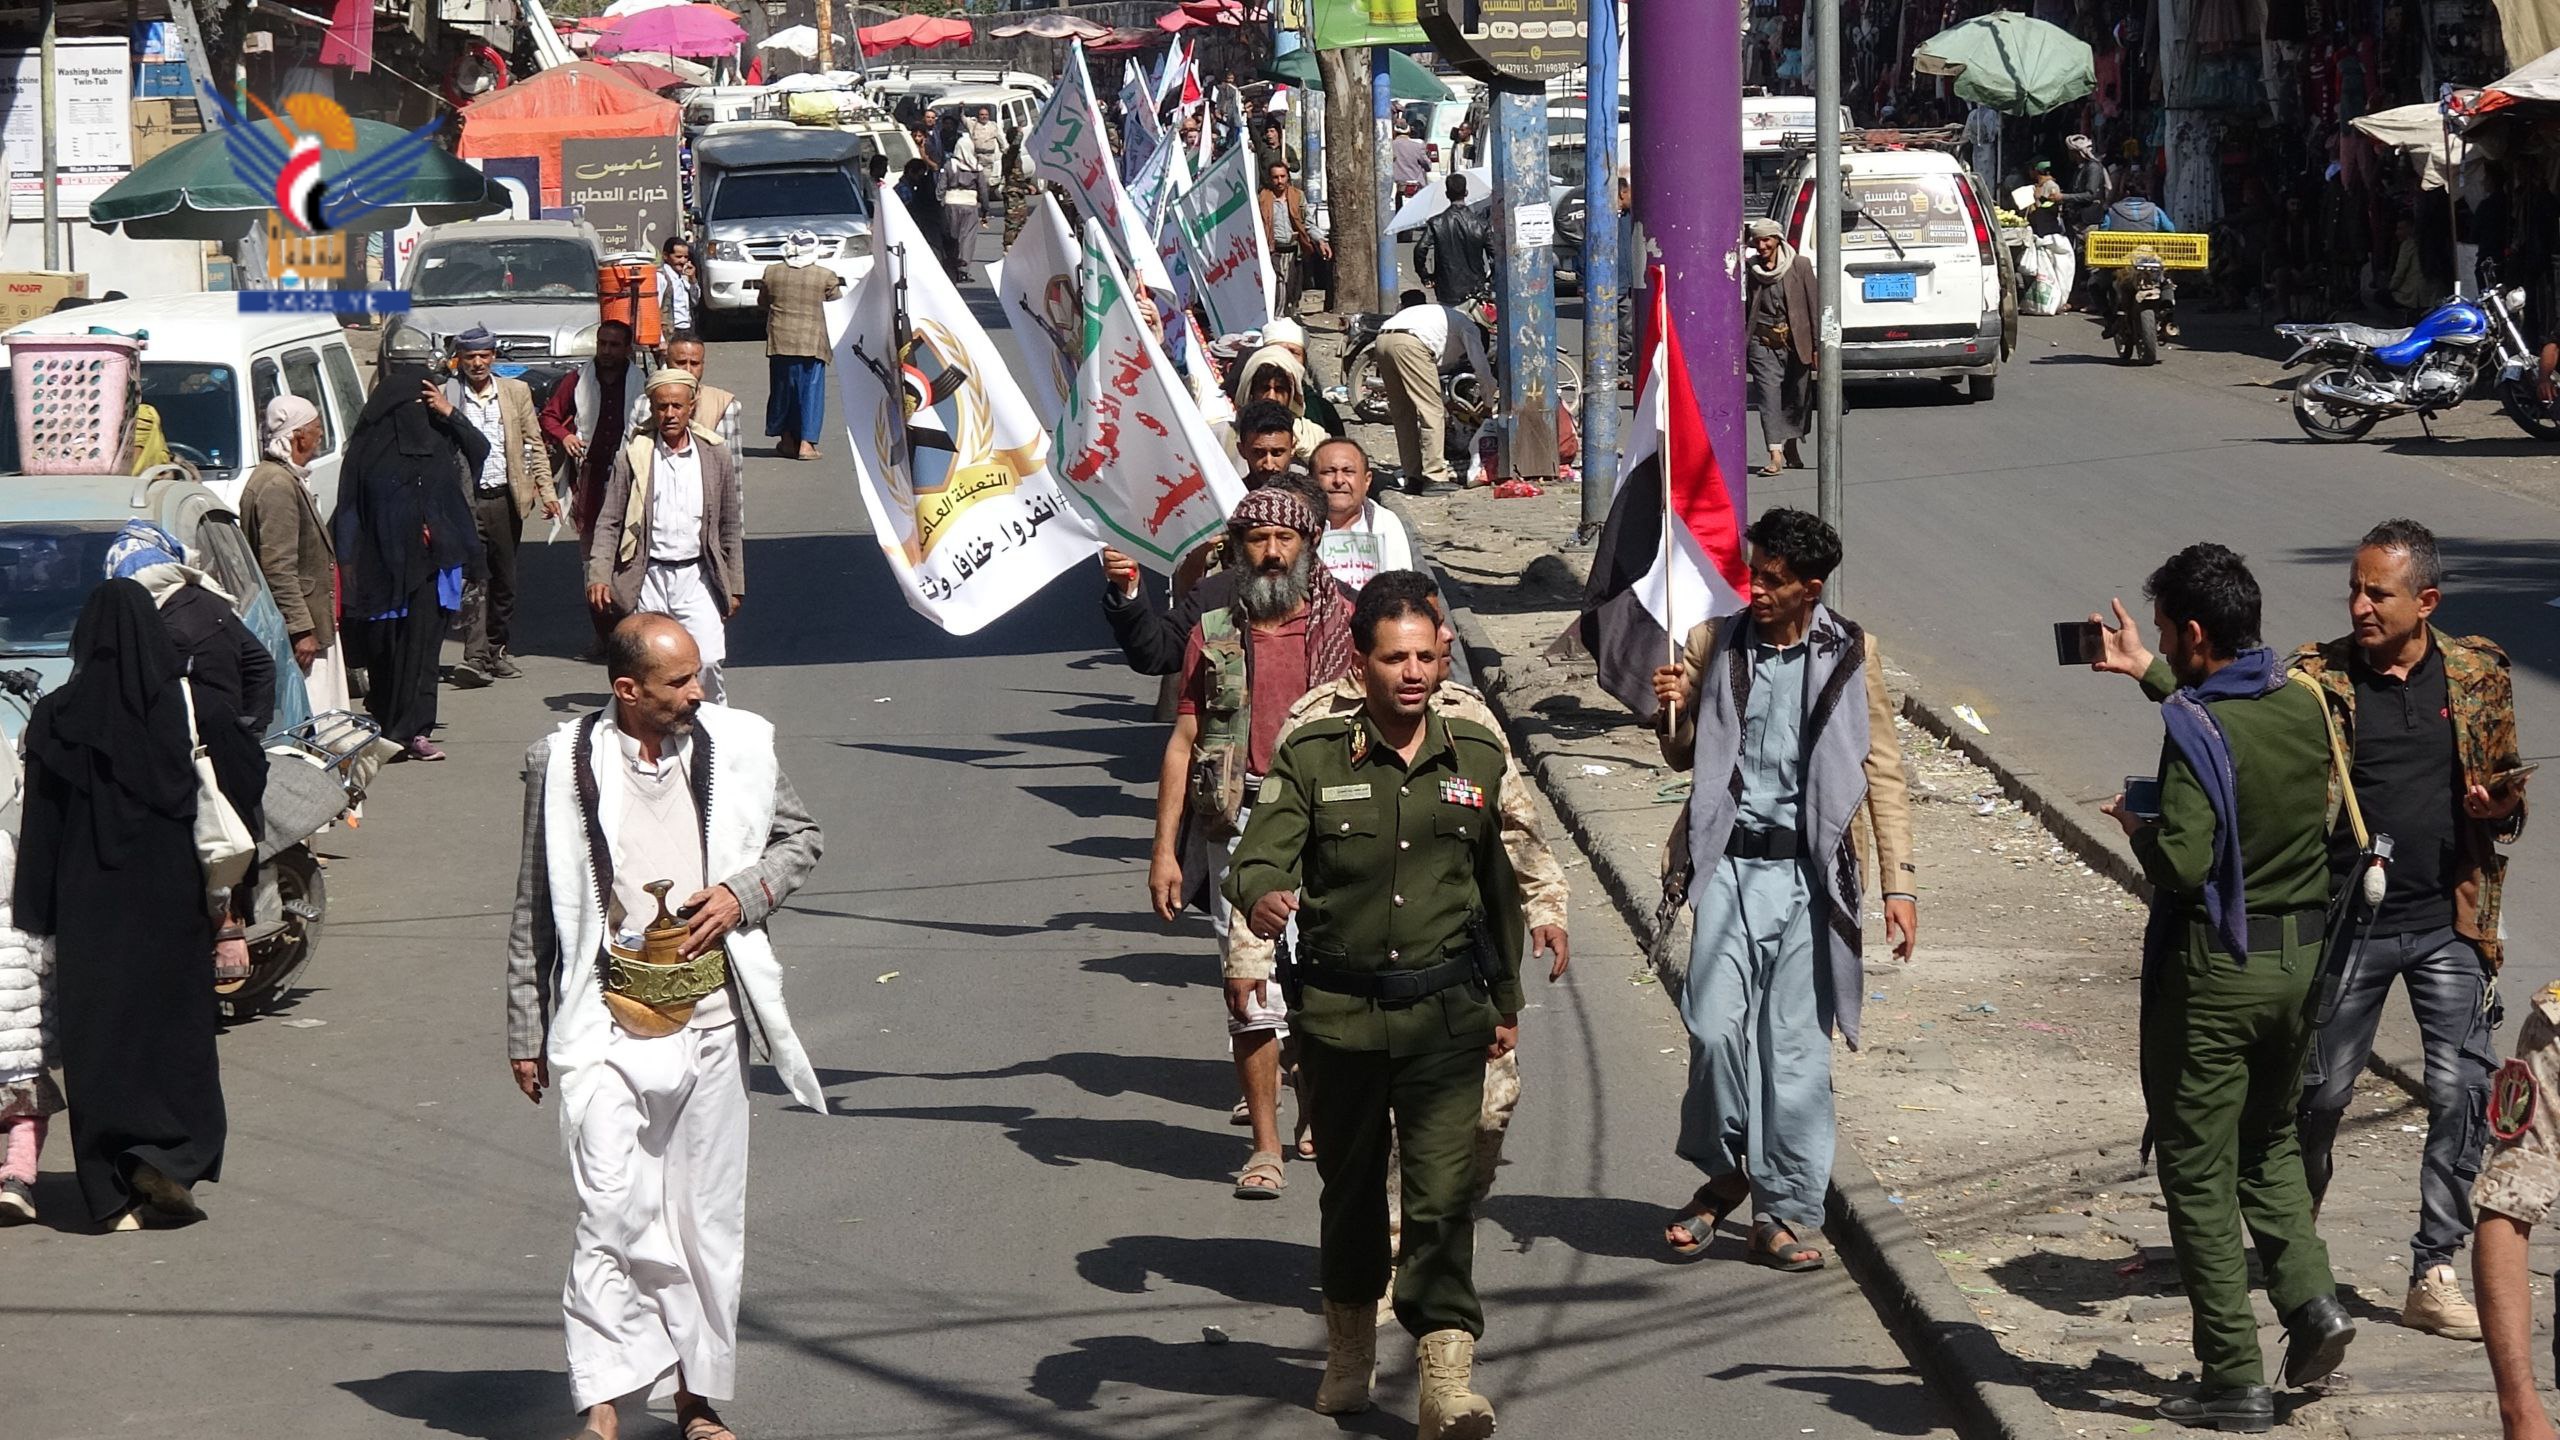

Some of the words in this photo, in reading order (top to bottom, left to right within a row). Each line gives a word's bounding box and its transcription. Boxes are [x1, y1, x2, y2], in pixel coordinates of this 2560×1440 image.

[58, 68, 89, 76] Washing
[570, 187, 624, 204] العطور
[1864, 189, 1908, 202] مؤسسة
[951, 471, 1008, 503] التعبئة
[919, 496, 954, 551] العام
